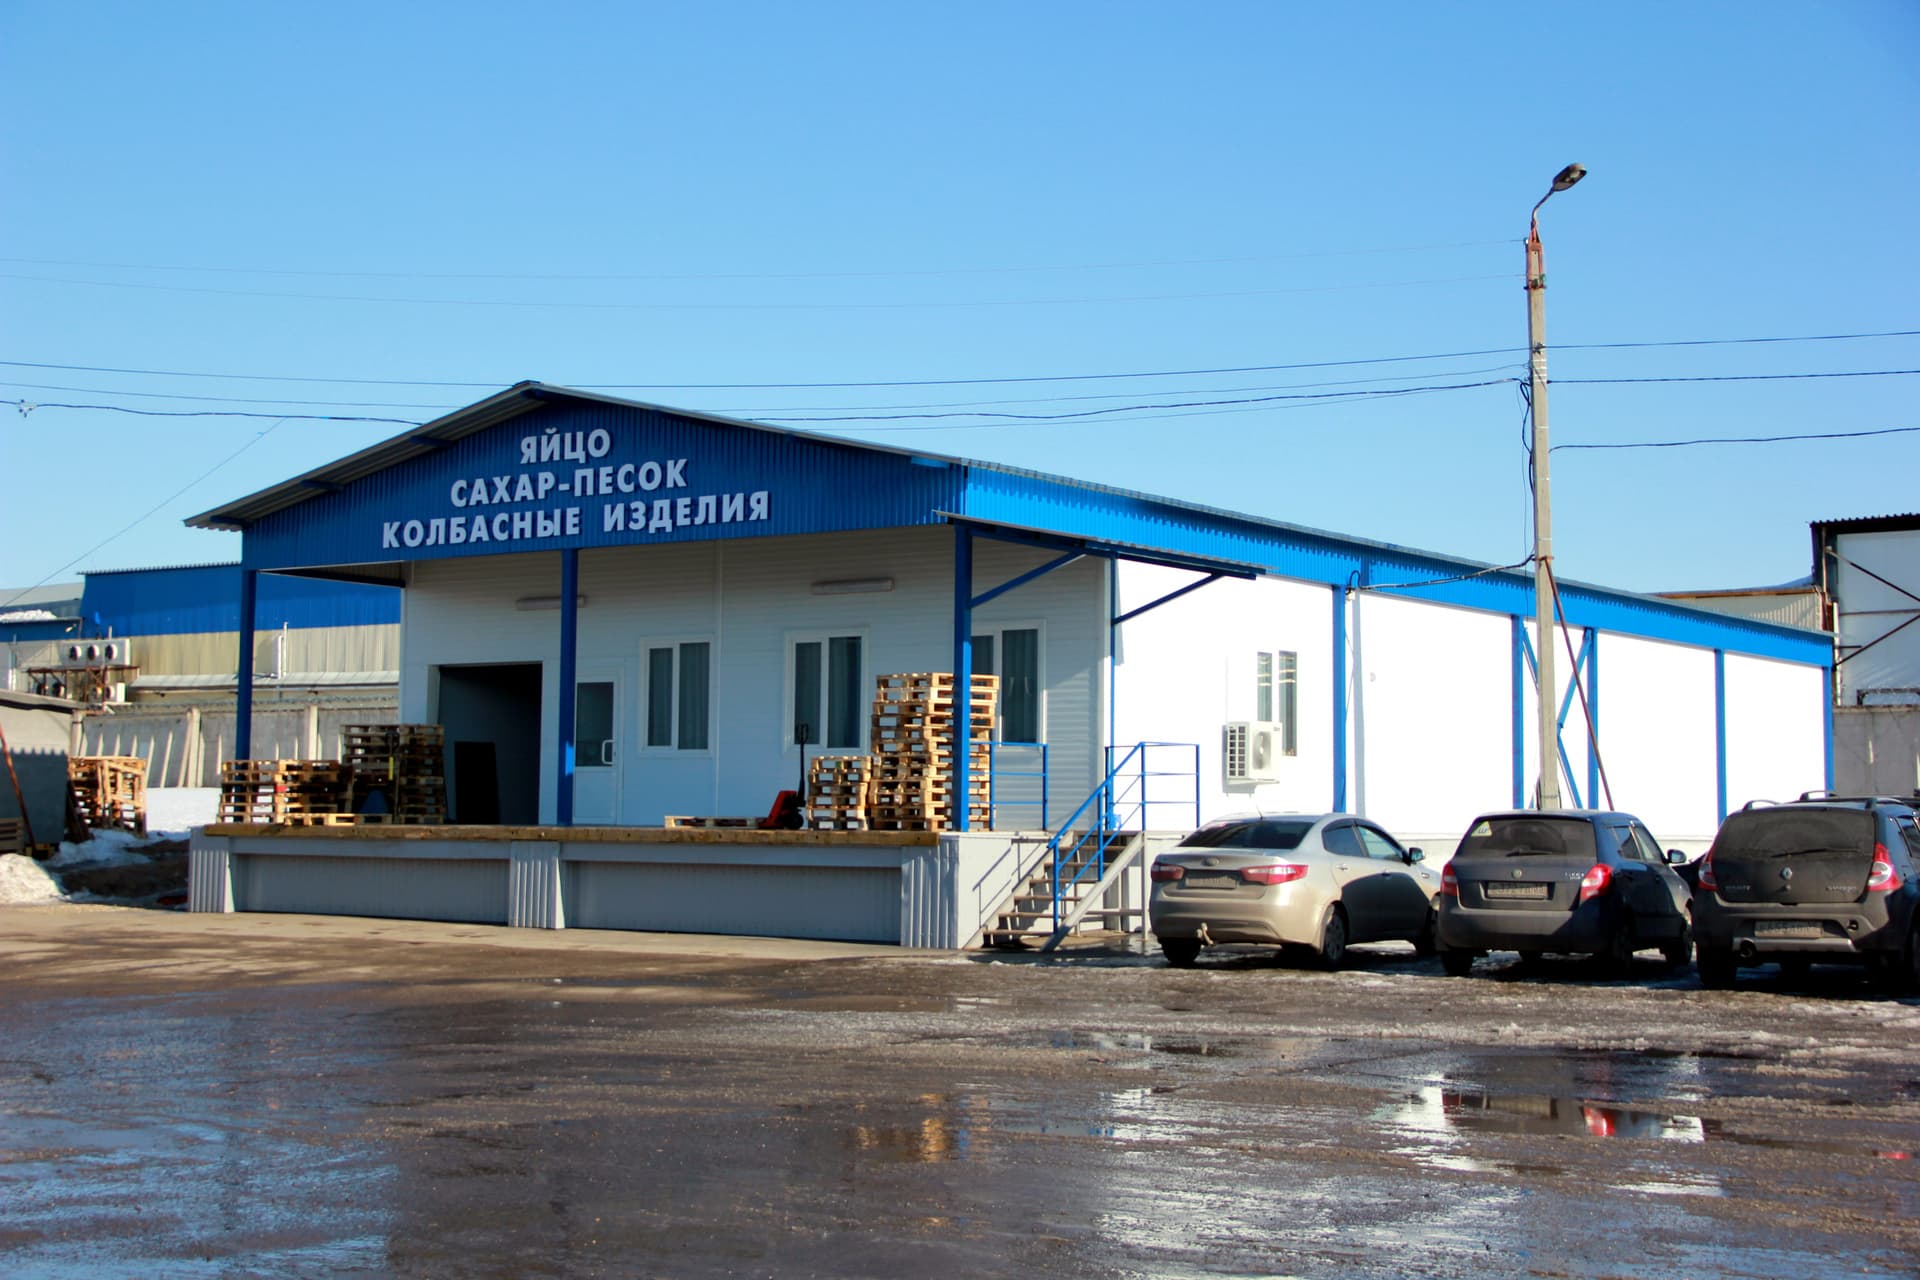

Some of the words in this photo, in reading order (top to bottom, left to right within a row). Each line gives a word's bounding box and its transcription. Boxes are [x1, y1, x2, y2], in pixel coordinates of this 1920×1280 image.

[519, 428, 610, 464] ЯЙЦО
[451, 459, 687, 507] САХАР-ПЕСОК
[382, 507, 580, 548] КОЛБАСНЫЕ
[603, 491, 768, 534] ИЗДЕЛИЯ
